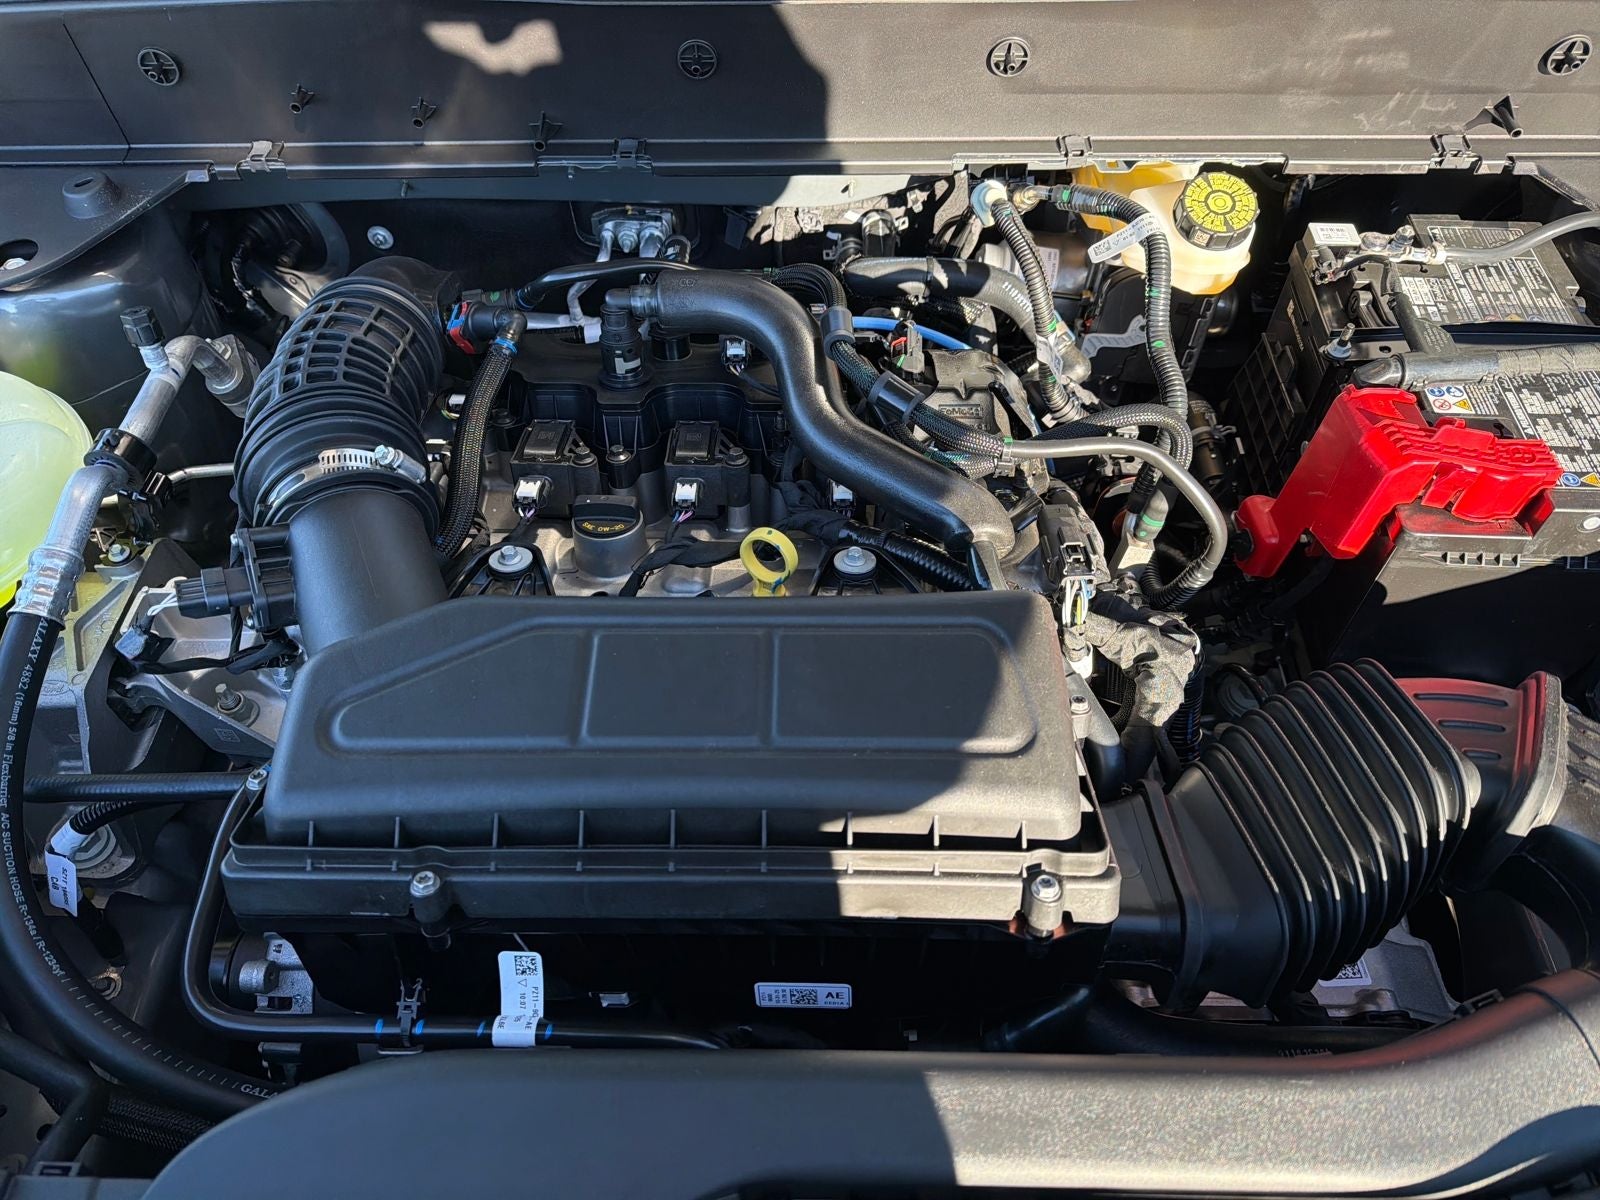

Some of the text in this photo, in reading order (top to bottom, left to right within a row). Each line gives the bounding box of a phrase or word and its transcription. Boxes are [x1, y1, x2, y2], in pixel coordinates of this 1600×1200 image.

[582, 521, 595, 530] SAE
[28, 617, 48, 663] ALAXY
[18, 664, 33, 690] 4882
[8, 692, 25, 725] (16mm)
[7, 726, 17, 741] 5/8
[0, 812, 11, 830] A/C
[2, 831, 17, 875] SUCTION
[9, 876, 25, 904] HOSE
[19, 904, 37, 936] R-134a
[36, 940, 66, 977] R-1234yf
[825, 991, 846, 1000] AE
